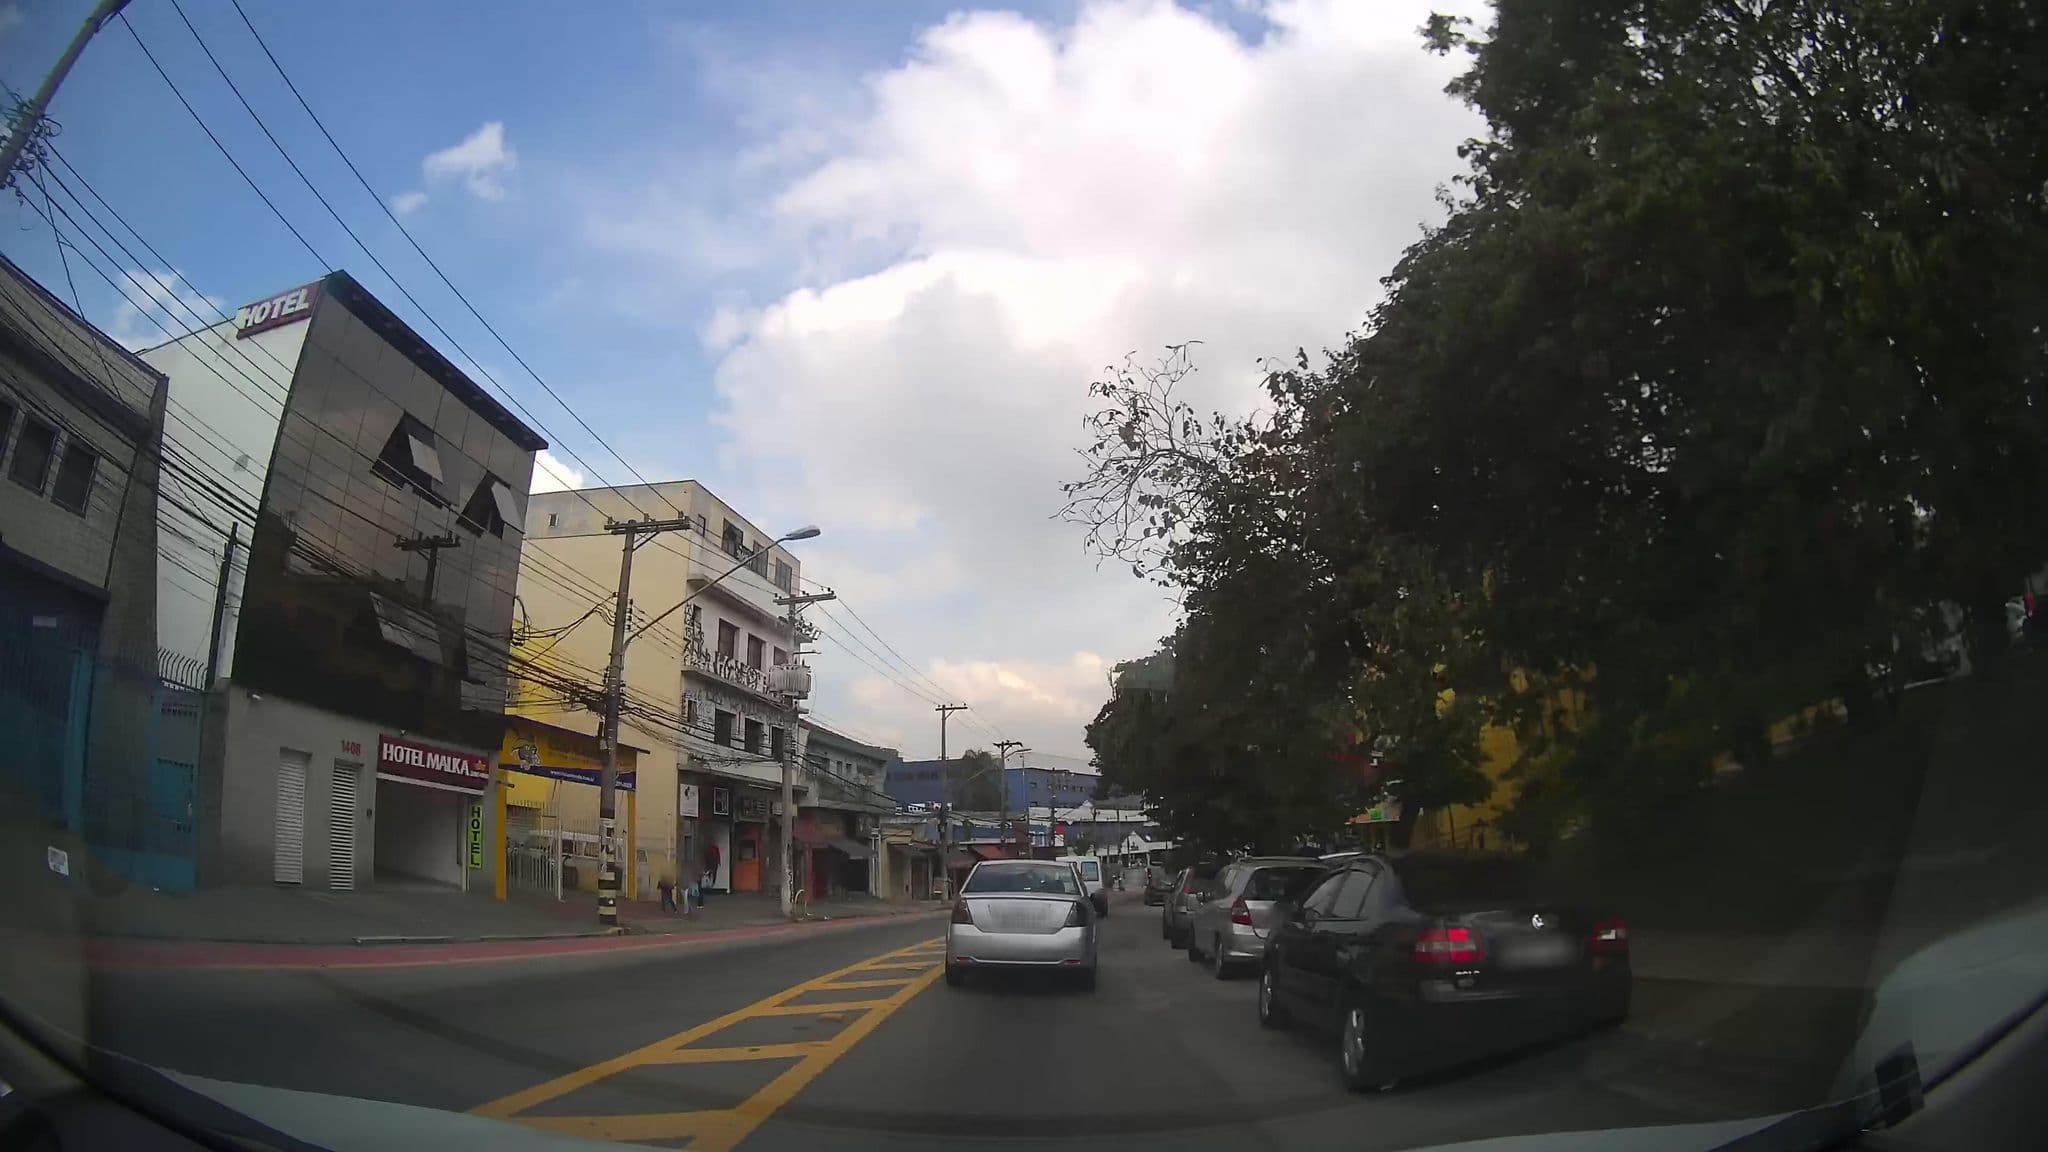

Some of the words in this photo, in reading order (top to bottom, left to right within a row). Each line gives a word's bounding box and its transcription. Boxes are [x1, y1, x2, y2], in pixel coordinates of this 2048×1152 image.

[237, 289, 309, 328] HOTEL
[382, 743, 425, 767] HOTEL
[426, 753, 469, 776] MALKA
[471, 807, 480, 866] HOTEL
